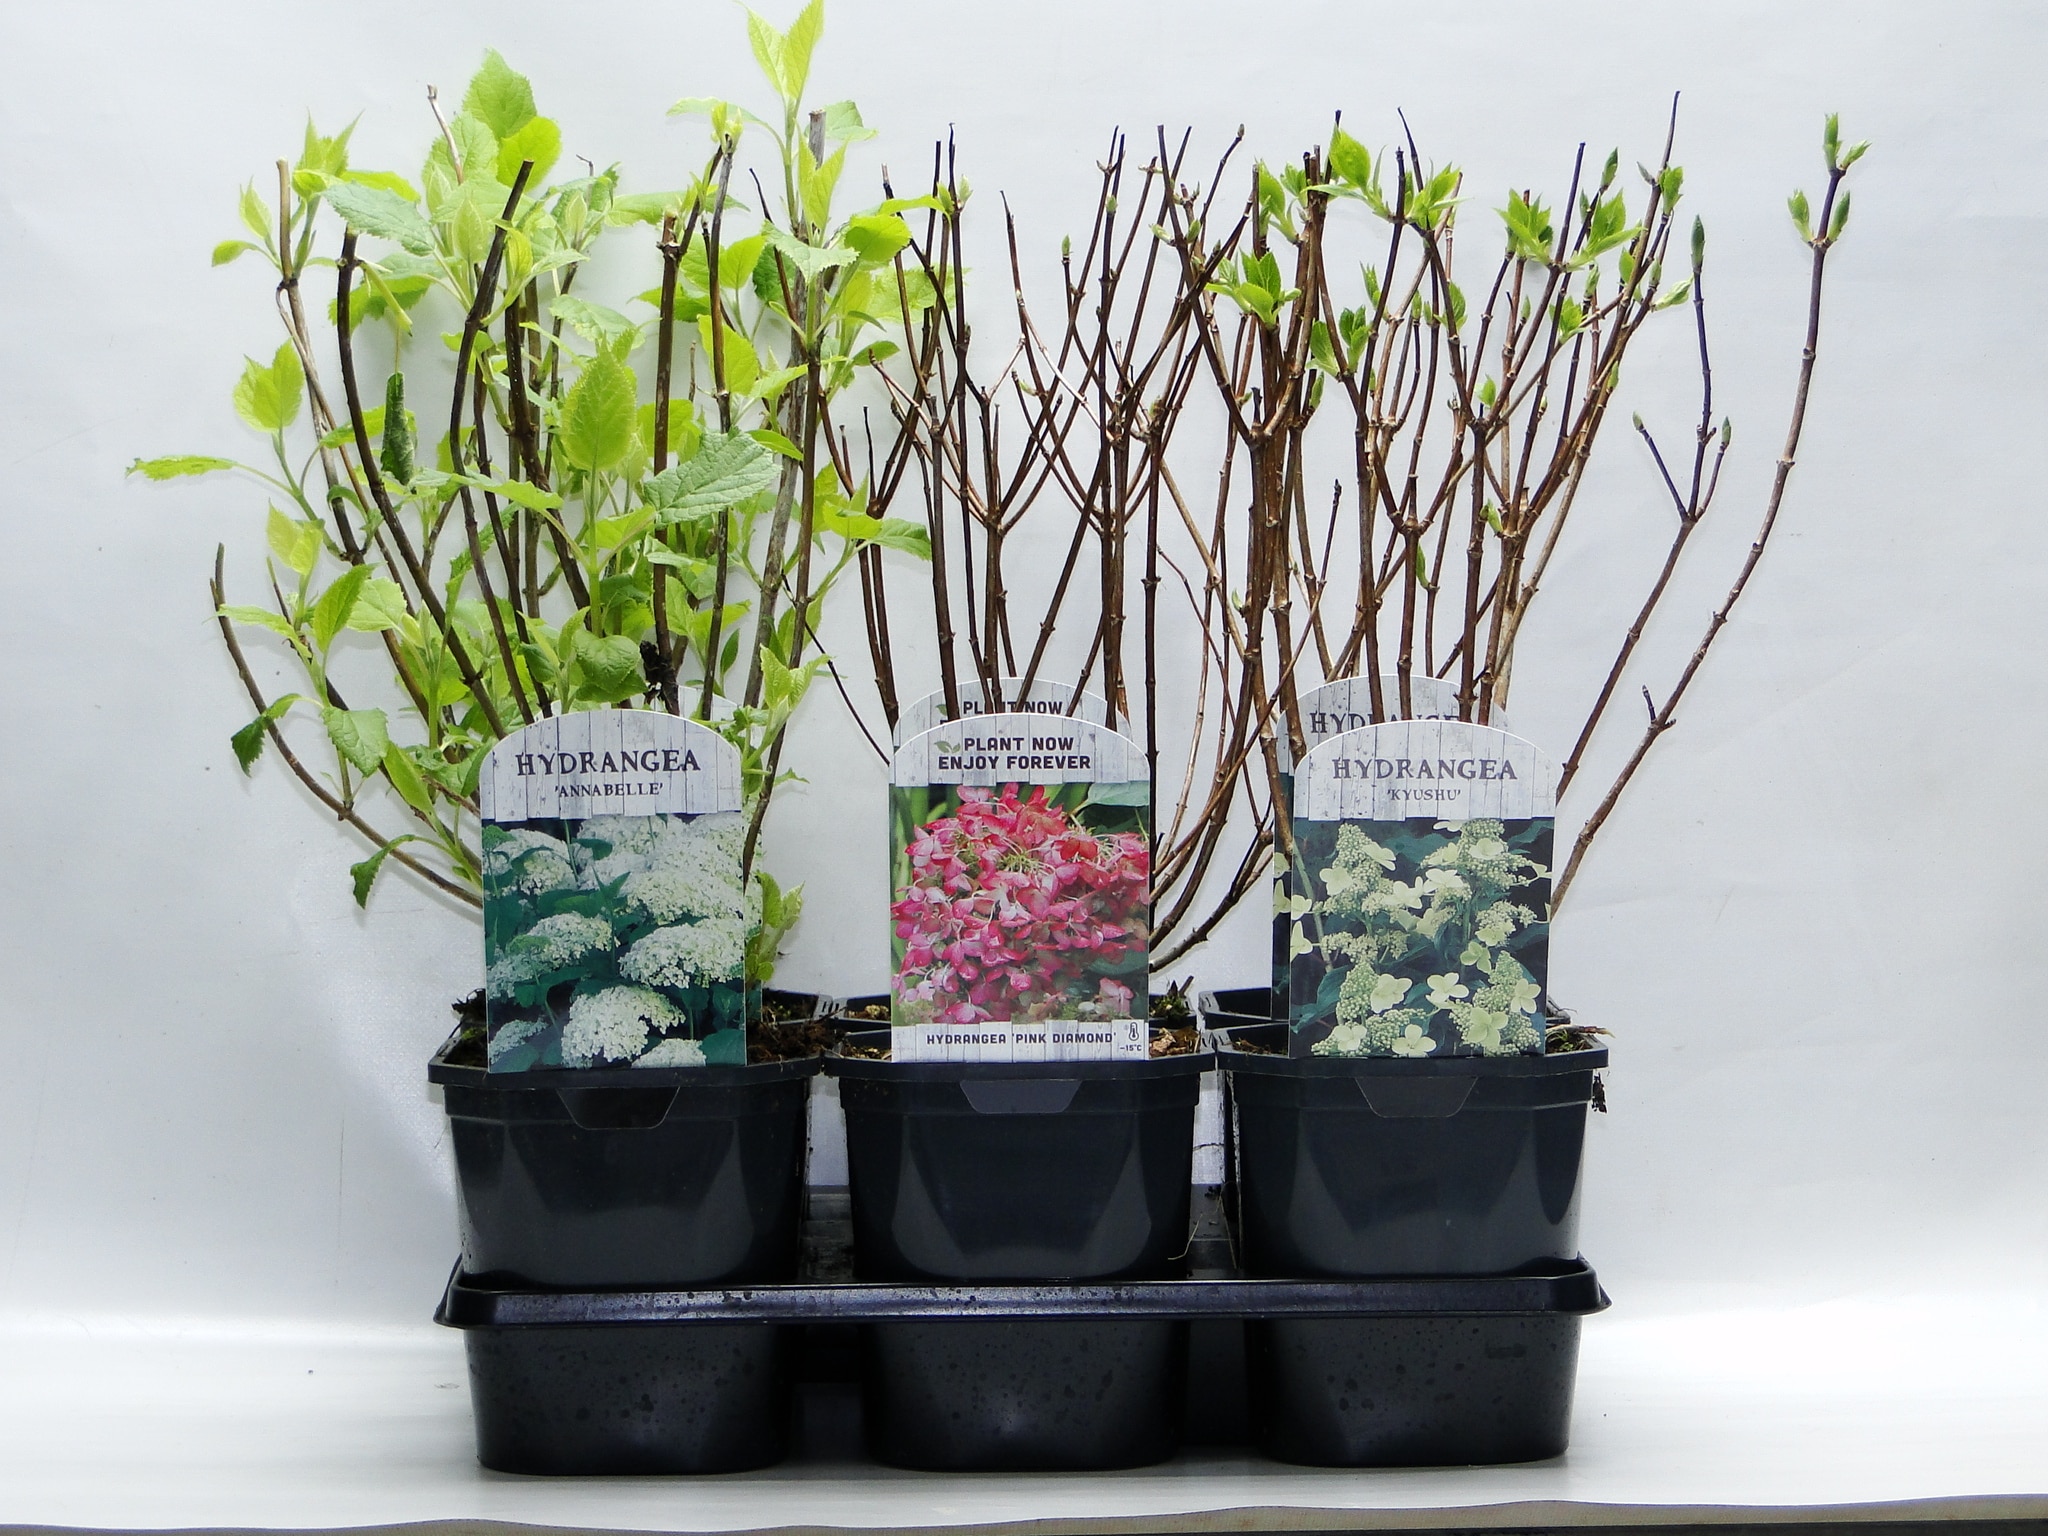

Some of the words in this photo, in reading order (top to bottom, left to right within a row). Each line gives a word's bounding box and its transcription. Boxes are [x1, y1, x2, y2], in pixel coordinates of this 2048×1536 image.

[1025, 701, 1063, 714] NOW
[964, 737, 1025, 751] PLANT
[1032, 737, 1074, 751] NOW
[515, 749, 701, 776] HYDRANGEA
[938, 756, 999, 770] ENJOY
[1006, 755, 1091, 769] FOREVER
[1332, 758, 1518, 780] HYDRANGEA
[554, 782, 664, 798] 'ANNABELLE'
[1387, 788, 1461, 801] 'KYUSHU'
[926, 1033, 1007, 1045] HYDRANGEA
[1012, 1032, 1047, 1044] 'PINK
[1052, 1031, 1117, 1044] DIAMOND'
